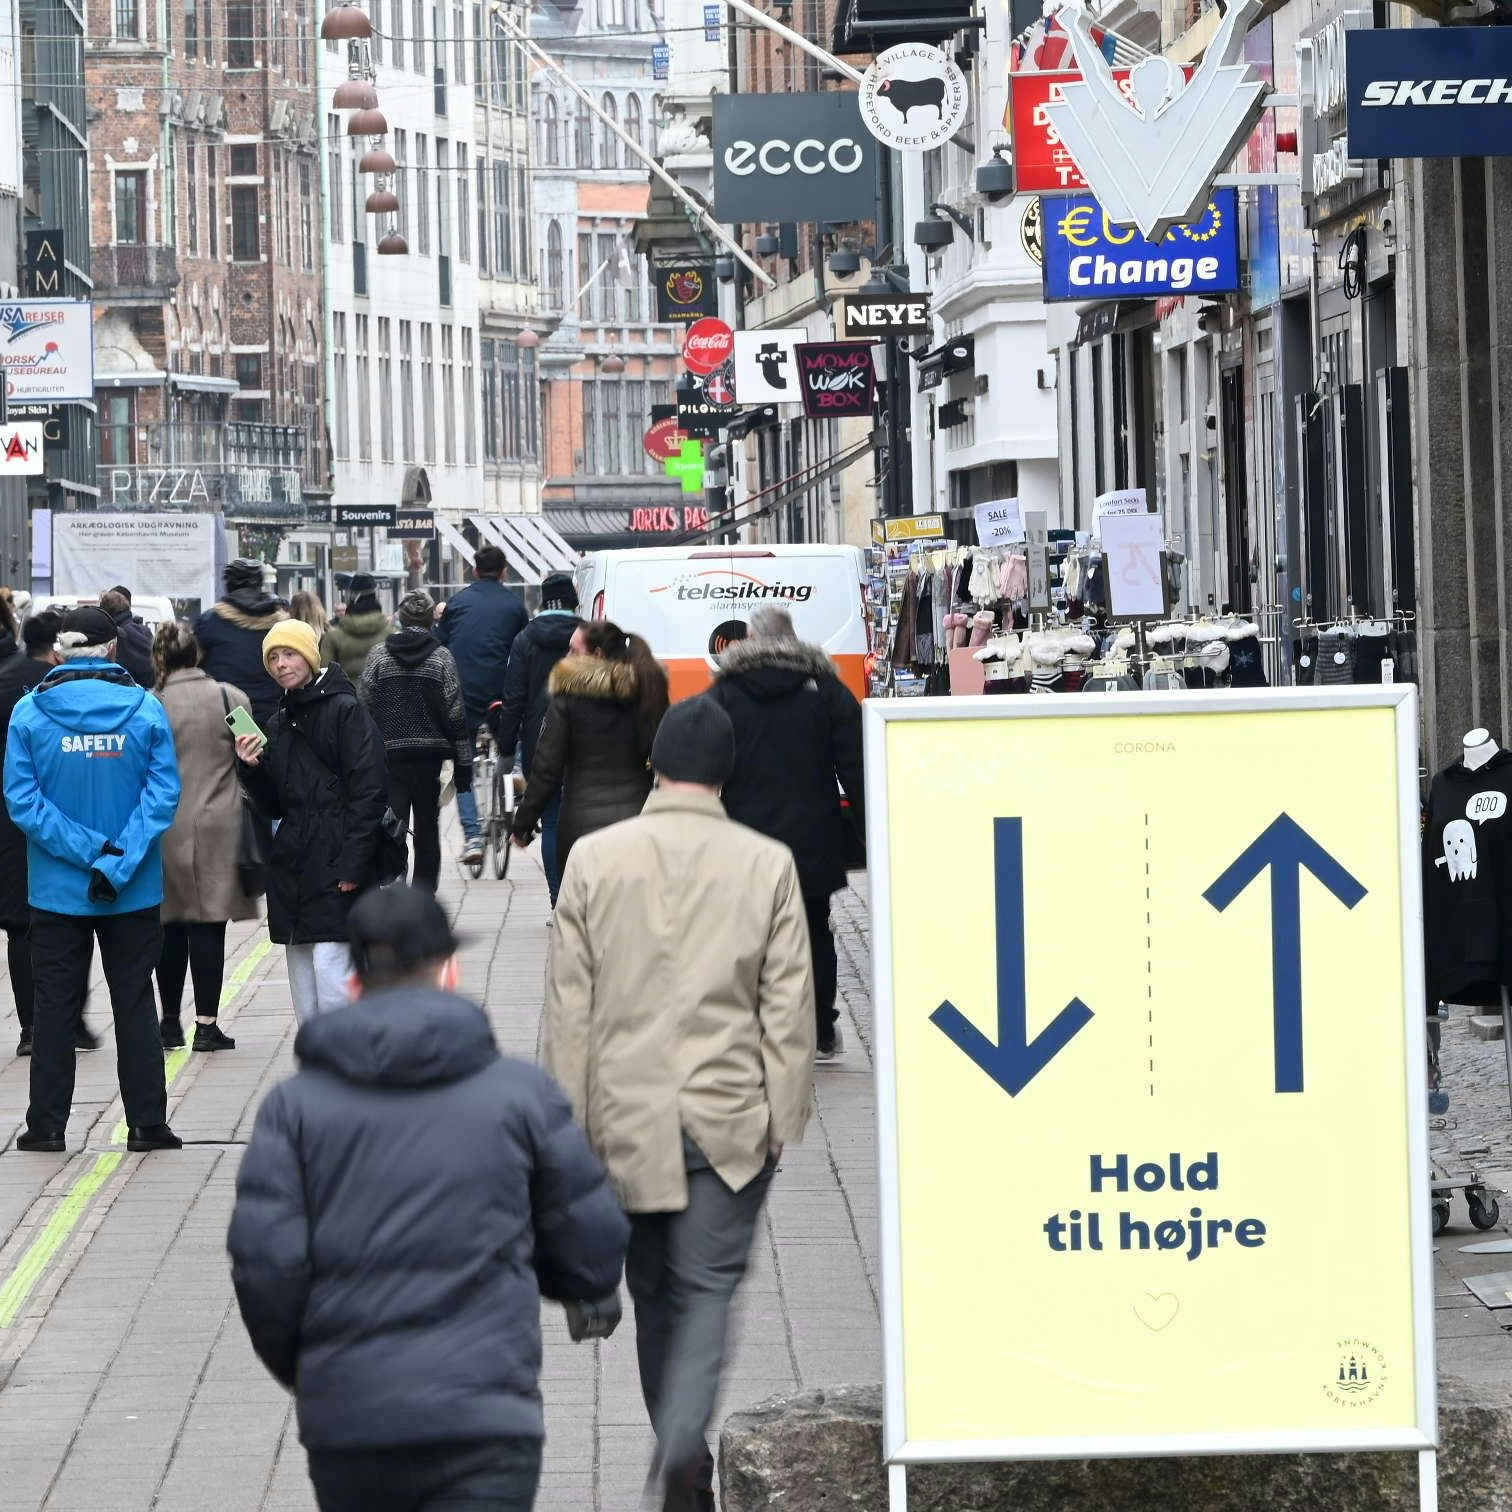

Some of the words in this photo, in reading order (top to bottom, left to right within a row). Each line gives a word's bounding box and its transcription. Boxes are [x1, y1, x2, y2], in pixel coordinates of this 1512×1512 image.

[883, 49, 936, 64] VILLAGE
[866, 74, 892, 138] HEREFORD
[895, 135, 928, 145] BEEF
[930, 130, 940, 140] &
[940, 66, 962, 133] SPARERIBS
[724, 138, 863, 176] ecco
[1069, 255, 1219, 289] Change
[25, 311, 65, 322] REJSER
[846, 304, 927, 326] NEYE
[805, 353, 870, 369] MOMO
[5, 366, 68, 375] JSEBUREAU
[816, 392, 862, 408] BOX
[112, 469, 210, 504] PIZZA
[341, 510, 391, 520] Souvenirs
[630, 507, 677, 532] JORCKS
[988, 508, 1008, 522] SALE
[138, 521, 199, 529] UDGRAVNING
[415, 519, 433, 529] BAR
[991, 525, 1012, 537] -20%
[677, 581, 812, 602] telesikring
[708, 601, 792, 611] alarmsyer
[61, 734, 127, 753] SAFETY
[1113, 742, 1177, 754] CORONA
[1474, 796, 1499, 814] BOO
[1089, 1151, 1219, 1193] Hold
[1043, 1209, 1104, 1252] til
[1118, 1206, 1268, 1262] højre
